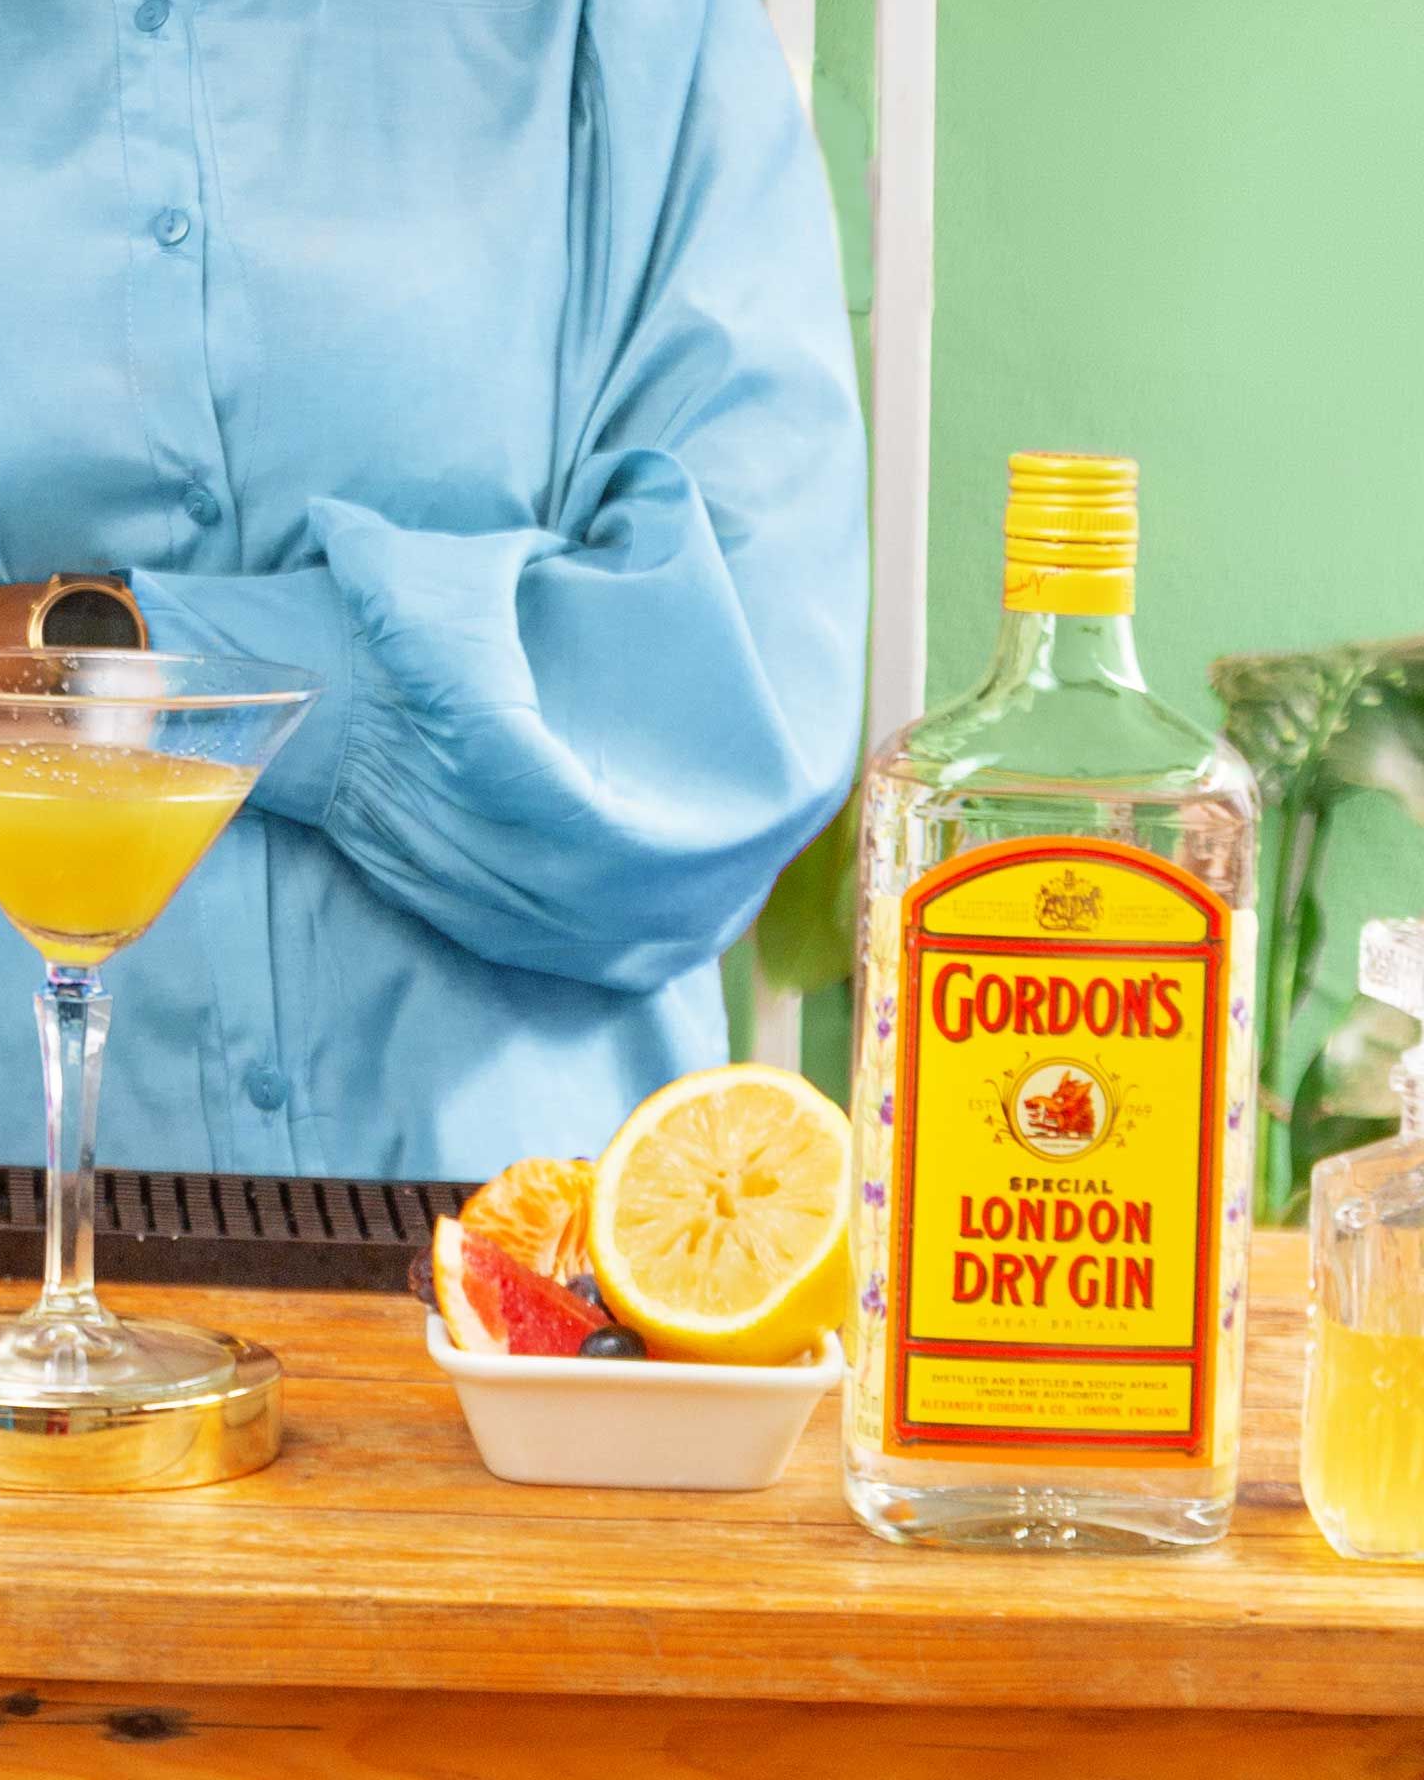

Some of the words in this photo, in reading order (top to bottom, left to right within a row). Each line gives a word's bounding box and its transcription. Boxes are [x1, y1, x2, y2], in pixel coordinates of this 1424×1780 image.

[932, 961, 1184, 1044] GORDON'S
[1009, 1176, 1114, 1195] SPECIAL
[959, 1195, 1153, 1244] LONDON
[952, 1250, 1058, 1307] DRY
[1067, 1254, 1154, 1310] GIN
[977, 1316, 1037, 1331] GREAT
[991, 1376, 1016, 1388] AND
[1018, 1376, 1069, 1389] BOTTLED
